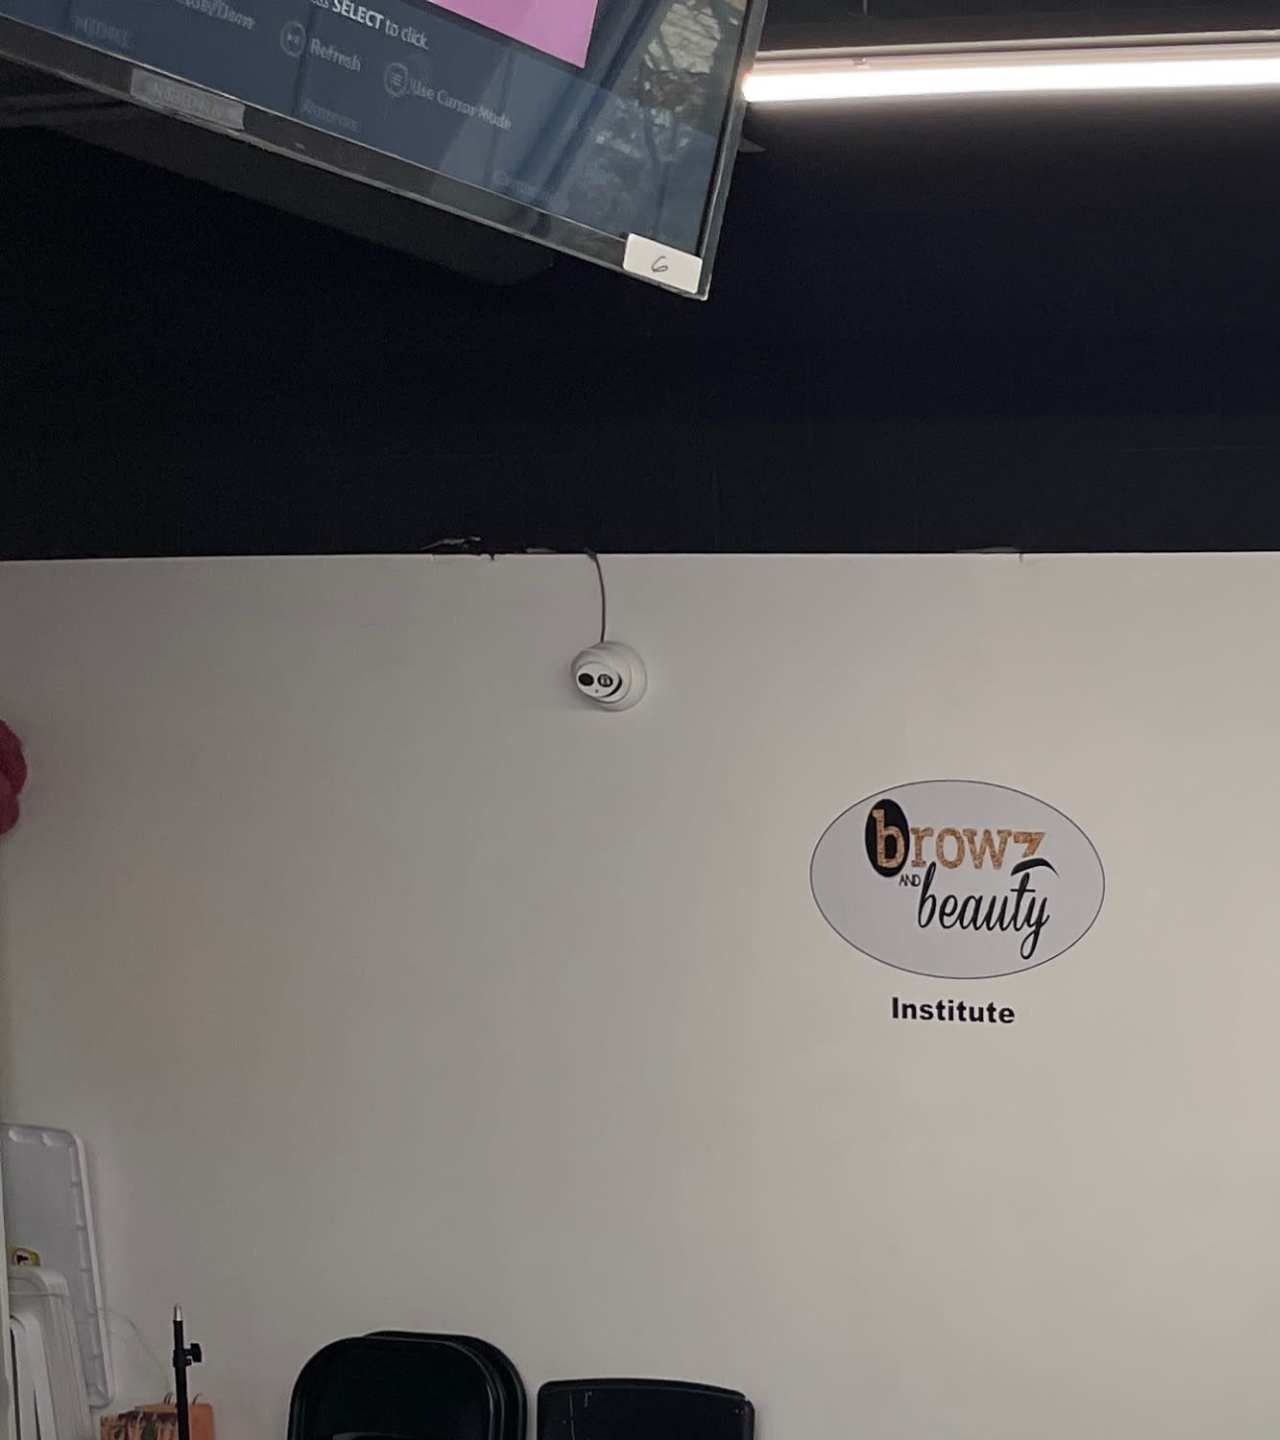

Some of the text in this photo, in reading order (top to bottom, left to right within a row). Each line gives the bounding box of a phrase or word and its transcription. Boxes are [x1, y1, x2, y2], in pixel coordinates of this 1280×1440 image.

[331, 0, 384, 29] SELECT
[385, 20, 399, 37] to
[310, 38, 361, 72] Refresh
[436, 89, 475, 116] Cursor
[870, 807, 1048, 872] browz
[899, 875, 921, 888] AND
[917, 862, 1051, 960] beauty
[891, 997, 1015, 1025] Institute
